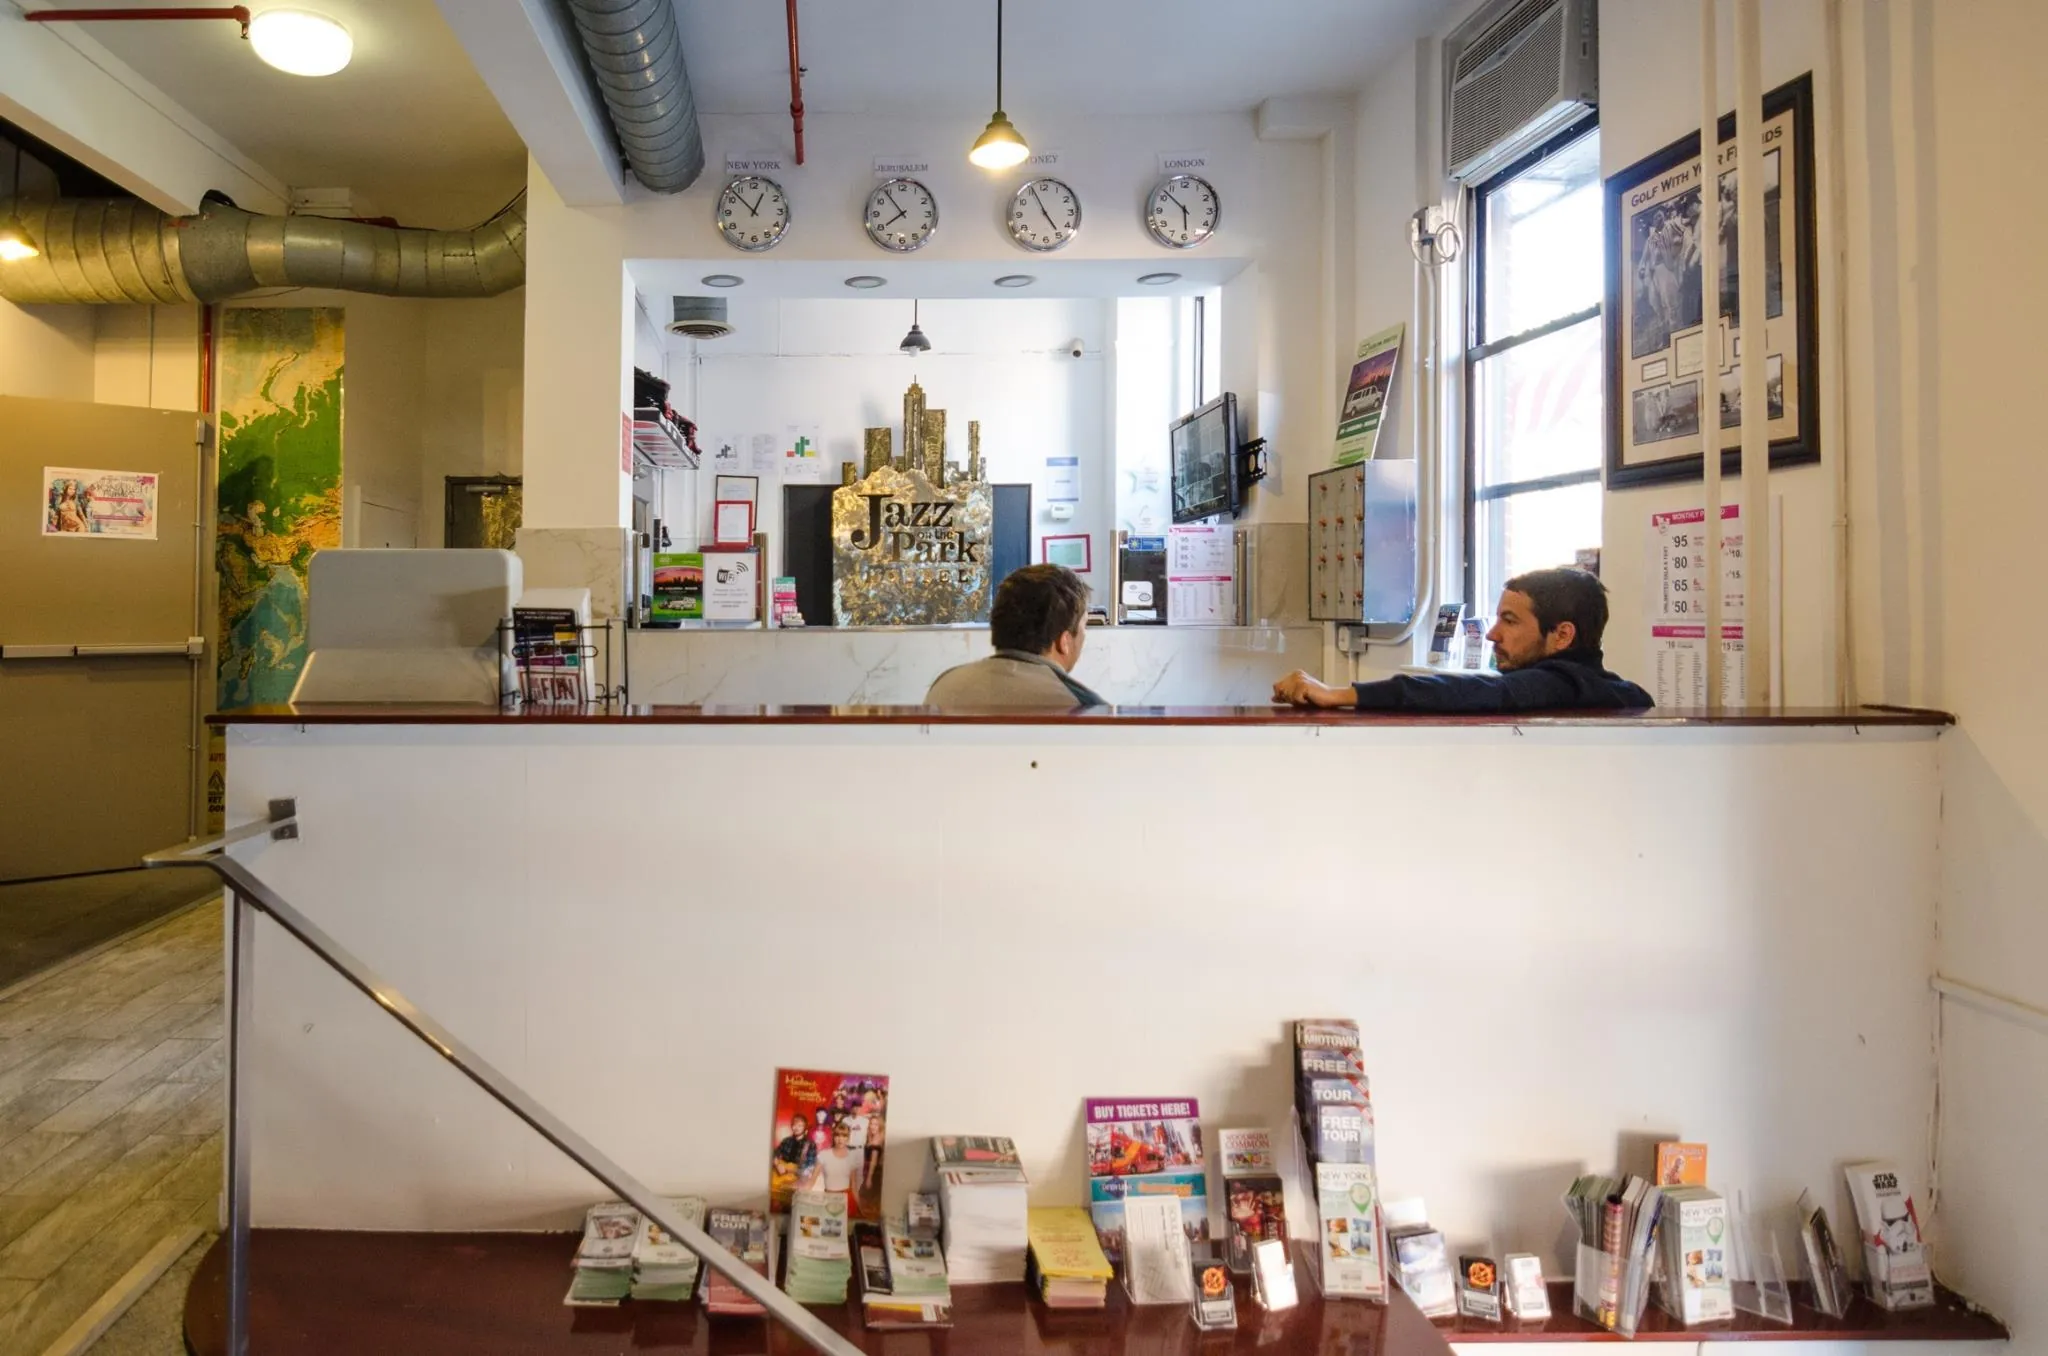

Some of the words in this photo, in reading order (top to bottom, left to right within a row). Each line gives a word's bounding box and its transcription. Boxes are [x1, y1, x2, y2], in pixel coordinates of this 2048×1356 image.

[727, 161, 750, 170] NEW
[753, 161, 782, 170] YORK
[874, 163, 929, 173] JERUSALEM
[1164, 159, 1206, 169] LONDON
[1631, 186, 1658, 207] GOLF
[1661, 170, 1690, 193] WITH
[850, 493, 955, 550] Jazz
[935, 528, 954, 540] the
[888, 531, 978, 563] Park
[1303, 1034, 1360, 1047] MIDTOWN
[1303, 1059, 1348, 1072] FREE
[1315, 1090, 1352, 1101] TOUR
[1094, 1105, 1115, 1119] BUY
[1116, 1103, 1159, 1118] TICKETS
[1160, 1102, 1191, 1116] HERE!
[1322, 1116, 1362, 1129] FREE
[1323, 1130, 1359, 1142] TOUR
[1319, 1171, 1340, 1180] NEW
[1344, 1171, 1367, 1180] YORK
[1872, 1173, 1898, 1183] STAR
[1873, 1180, 1898, 1190] WARS
[1682, 1207, 1701, 1217] NEW
[1702, 1206, 1723, 1215] YORK
[711, 1213, 750, 1224] FREE
[713, 1221, 748, 1230] TOUR
